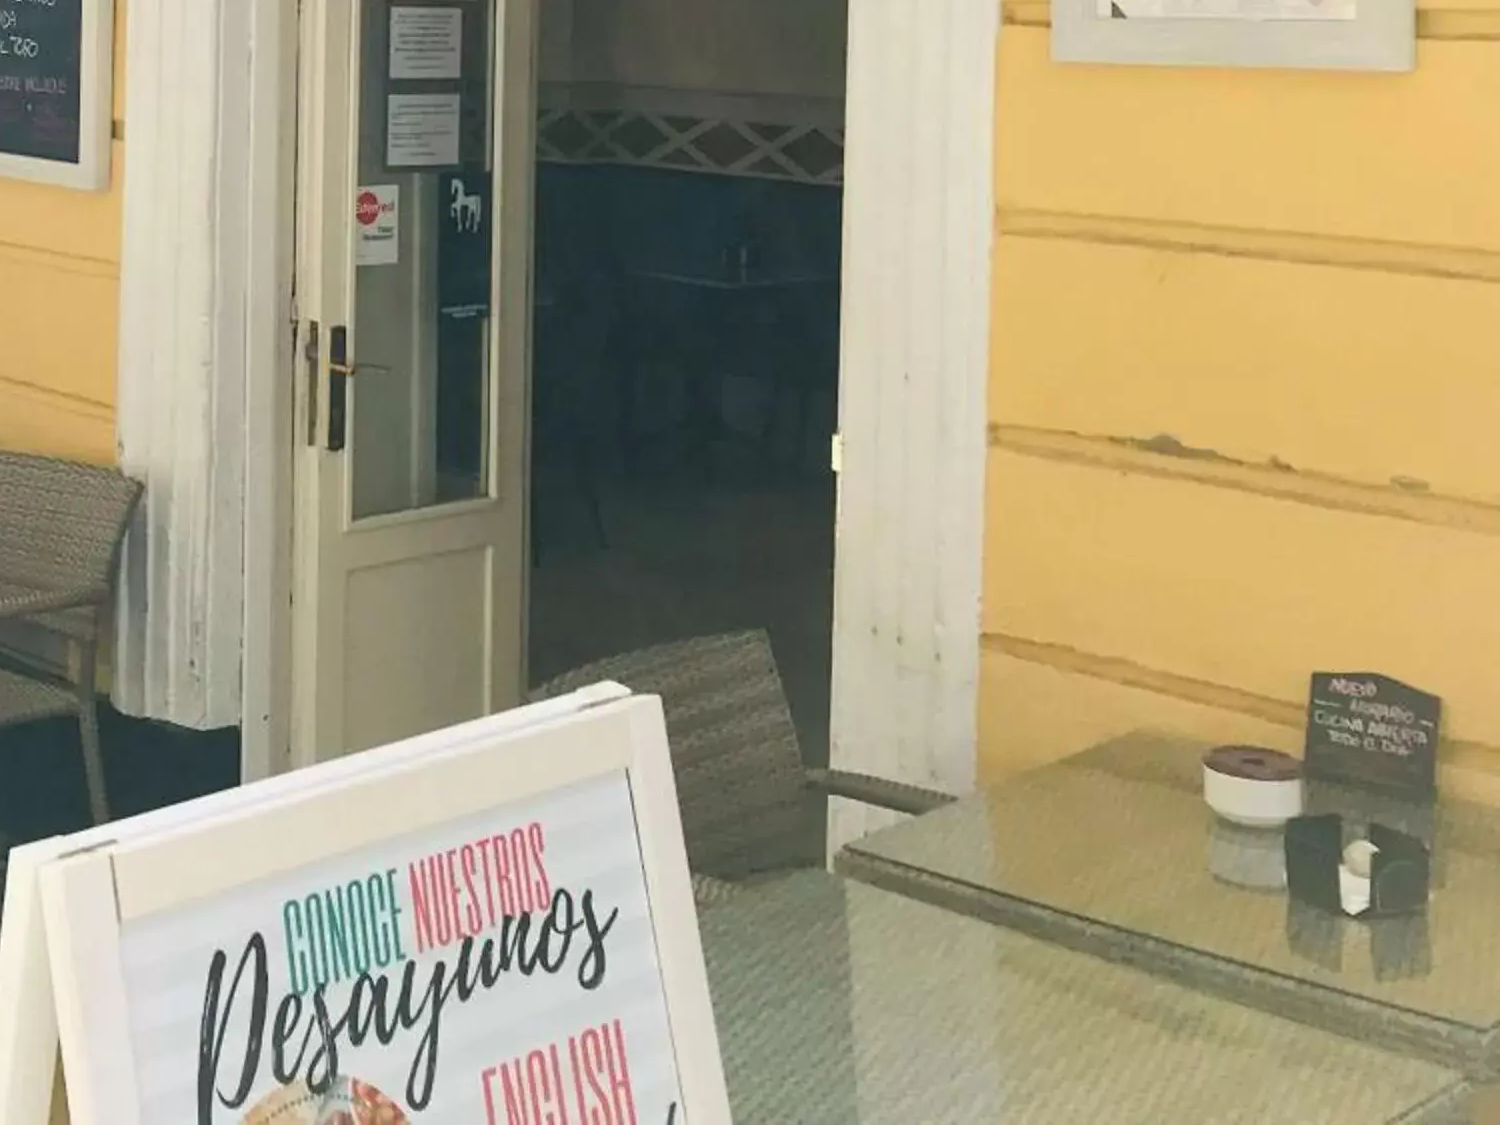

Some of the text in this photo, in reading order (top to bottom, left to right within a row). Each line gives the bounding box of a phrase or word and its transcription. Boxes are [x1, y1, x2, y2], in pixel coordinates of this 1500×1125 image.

[283, 821, 551, 996] CONOCE NUESTROS
[198, 887, 619, 1125] Desayunos
[481, 1019, 638, 1125] ENGLISH
